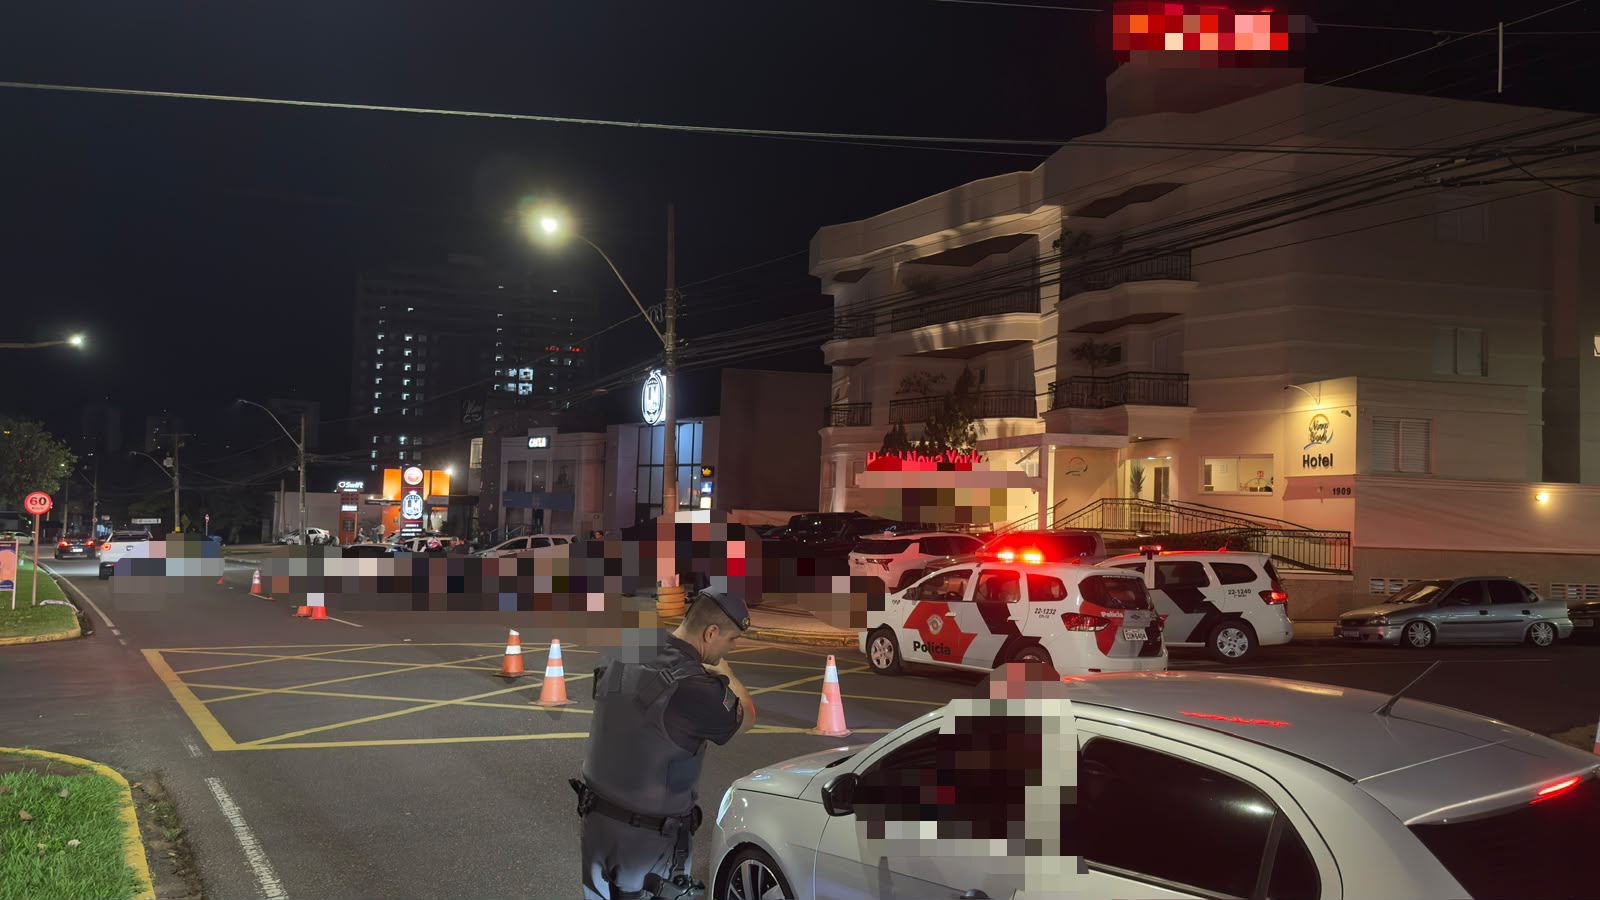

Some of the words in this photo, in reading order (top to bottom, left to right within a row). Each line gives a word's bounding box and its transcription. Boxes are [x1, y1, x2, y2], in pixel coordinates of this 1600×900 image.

[1303, 453, 1333, 468] Hotel
[1333, 487, 1351, 496] 1909
[30, 496, 46, 506] 60
